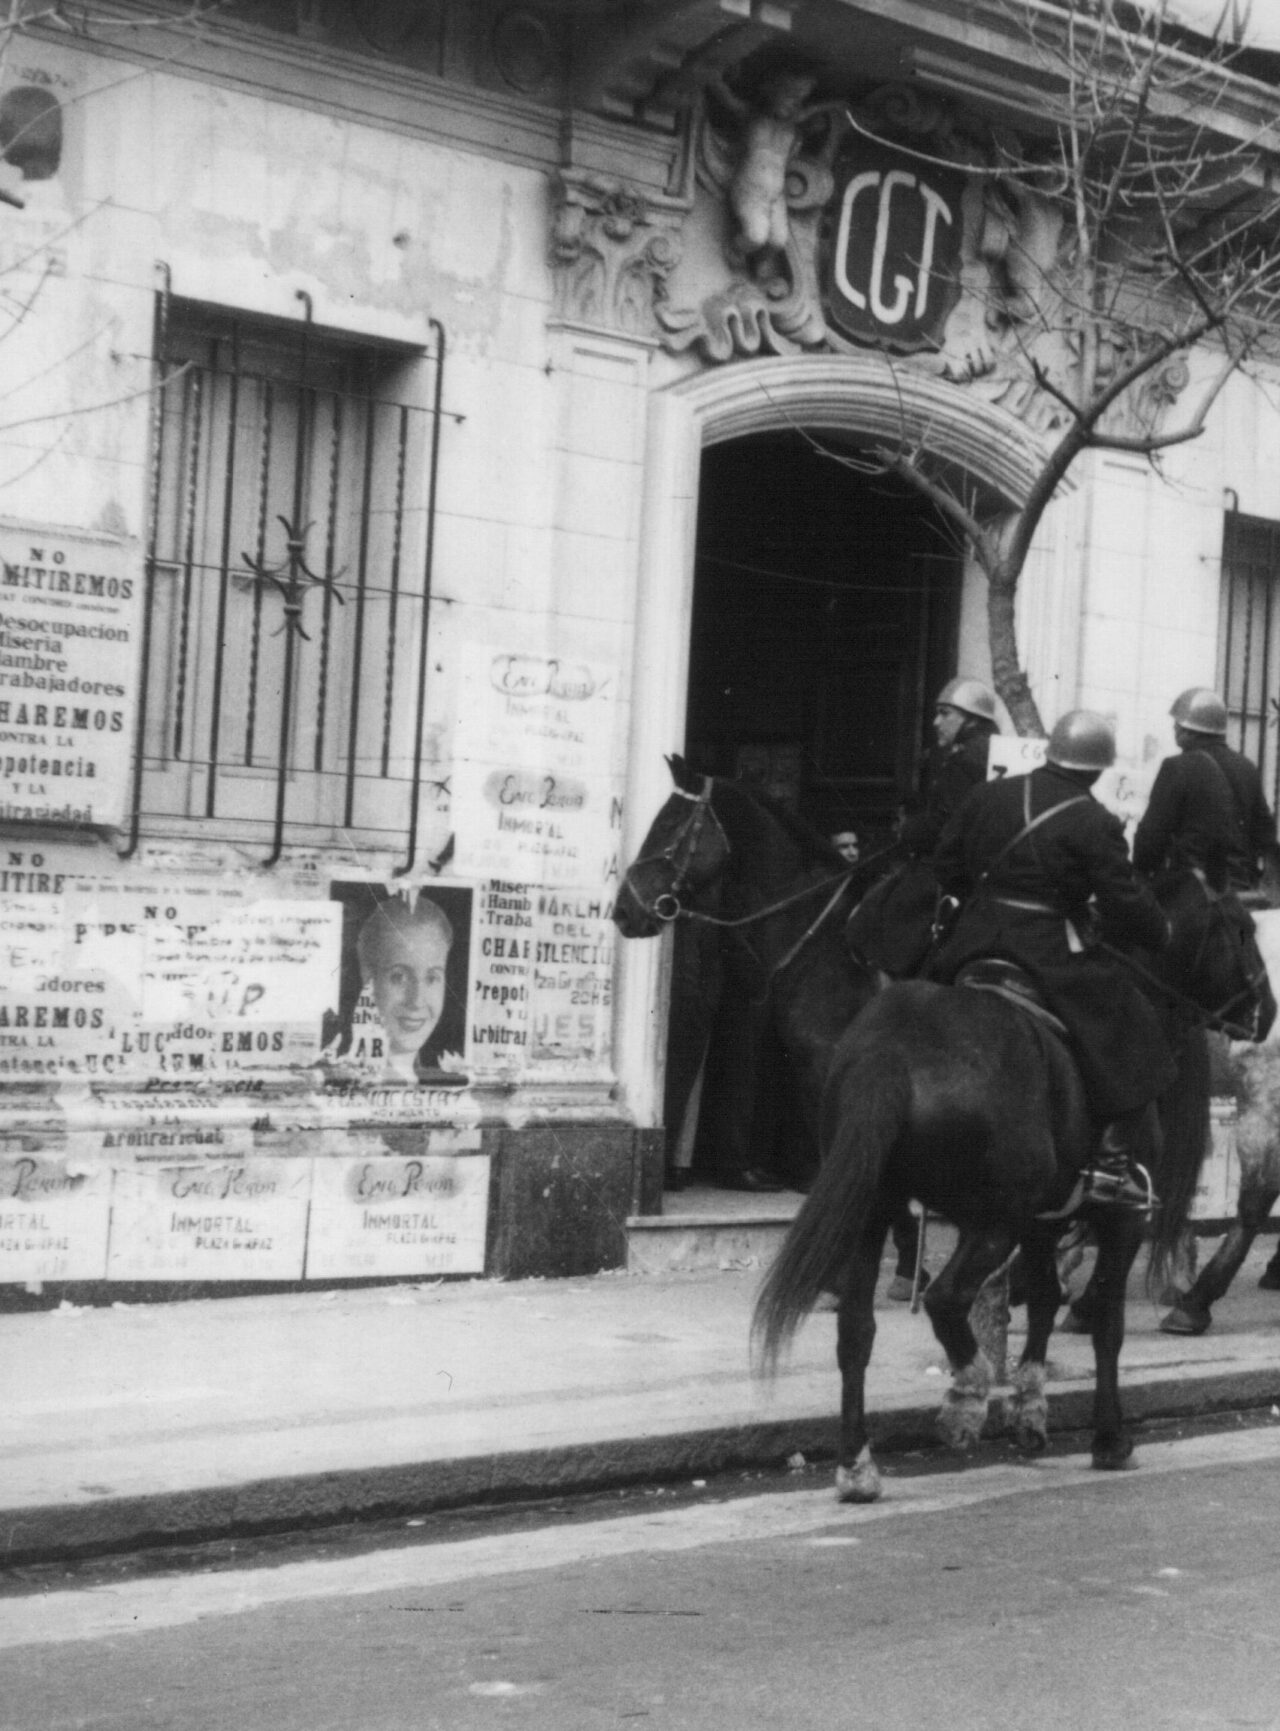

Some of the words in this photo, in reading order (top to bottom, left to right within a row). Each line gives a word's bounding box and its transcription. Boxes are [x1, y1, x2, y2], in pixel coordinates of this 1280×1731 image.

[834, 170, 953, 324] CGT
[30, 547, 65, 565] NO
[0, 615, 129, 642] esocupacion
[0, 754, 96, 778] potencia
[9, 852, 45, 867] NO
[144, 906, 178, 920] NO
[170, 1212, 254, 1233] INMORTAL
[361, 1209, 440, 1230] INMORTAL
